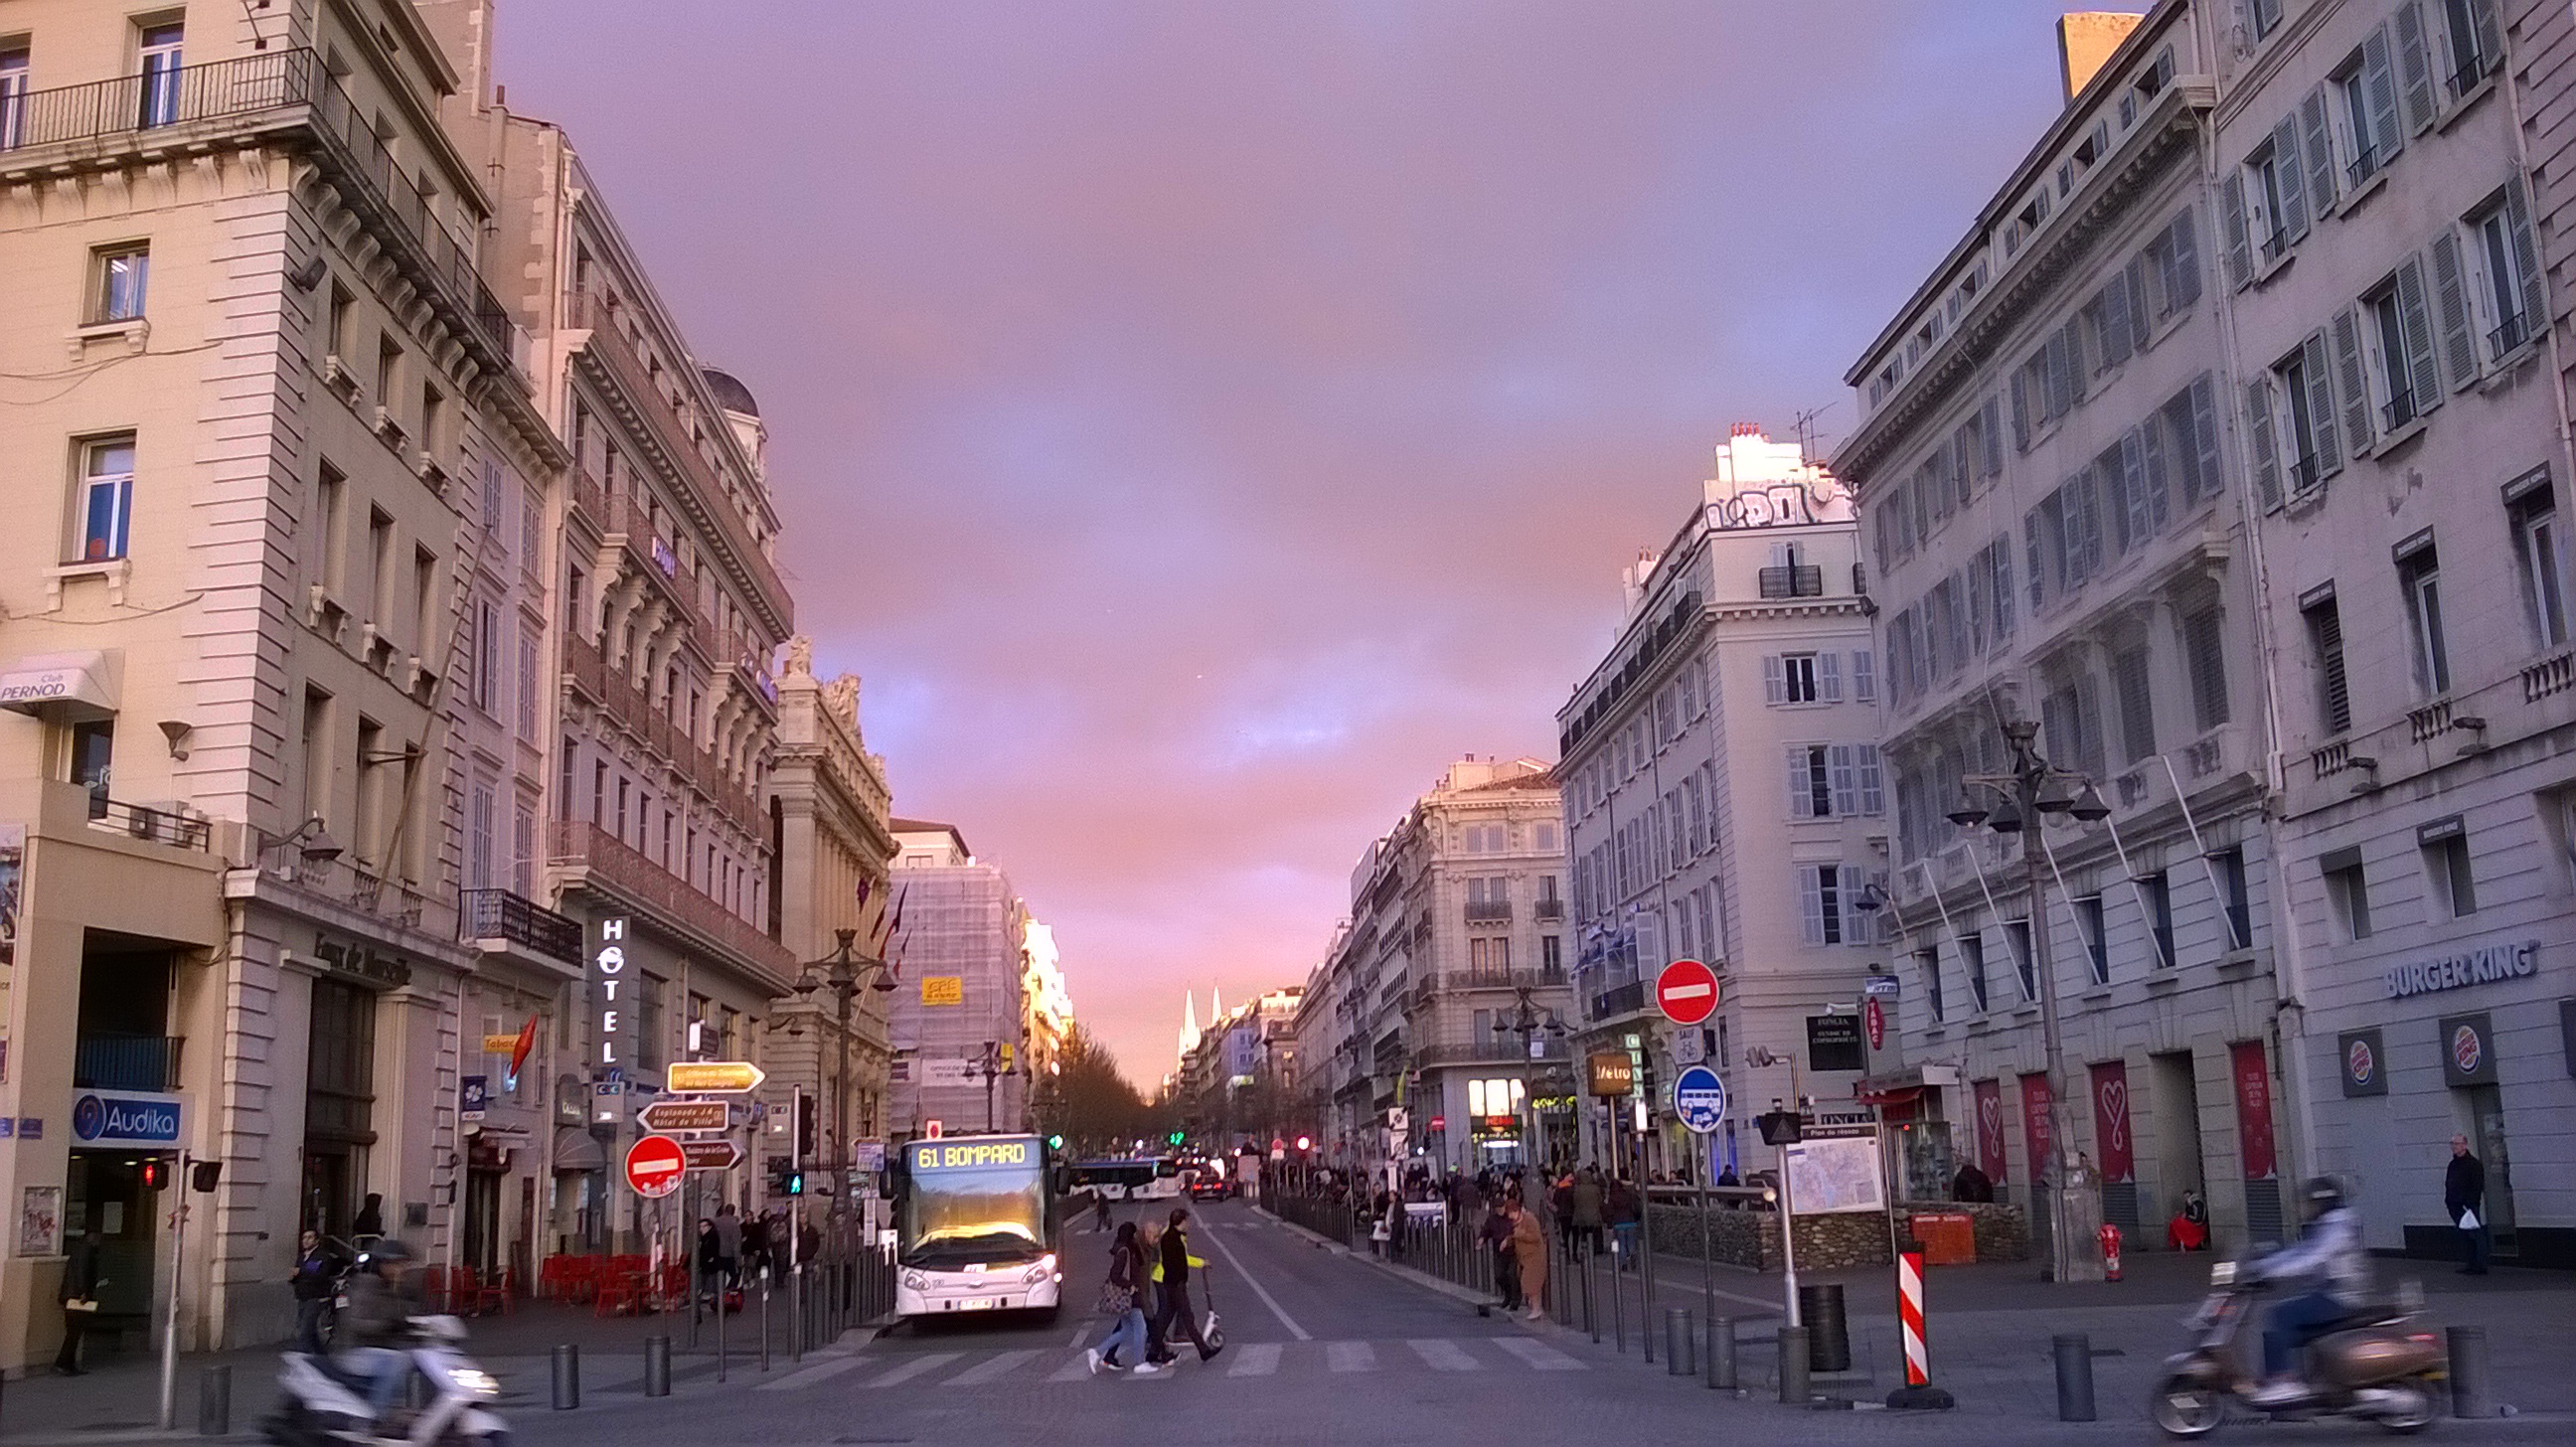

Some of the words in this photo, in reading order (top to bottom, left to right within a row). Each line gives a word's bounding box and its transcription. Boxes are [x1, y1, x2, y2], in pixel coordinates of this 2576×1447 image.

[41, 674, 64, 683] Club
[1, 683, 66, 699] PERNOD
[2386, 955, 2468, 997] BURGER
[2471, 944, 2533, 984] KING
[596, 919, 625, 1062] HOTEL
[1869, 1003, 1879, 1043] TABAC
[486, 1039, 515, 1048] Tabac
[1595, 1064, 1631, 1080] Métro
[106, 1106, 175, 1134] Audika
[655, 1108, 697, 1117] Esplanade
[918, 1148, 940, 1168] 61
[944, 1143, 1026, 1167] BOMPARD
